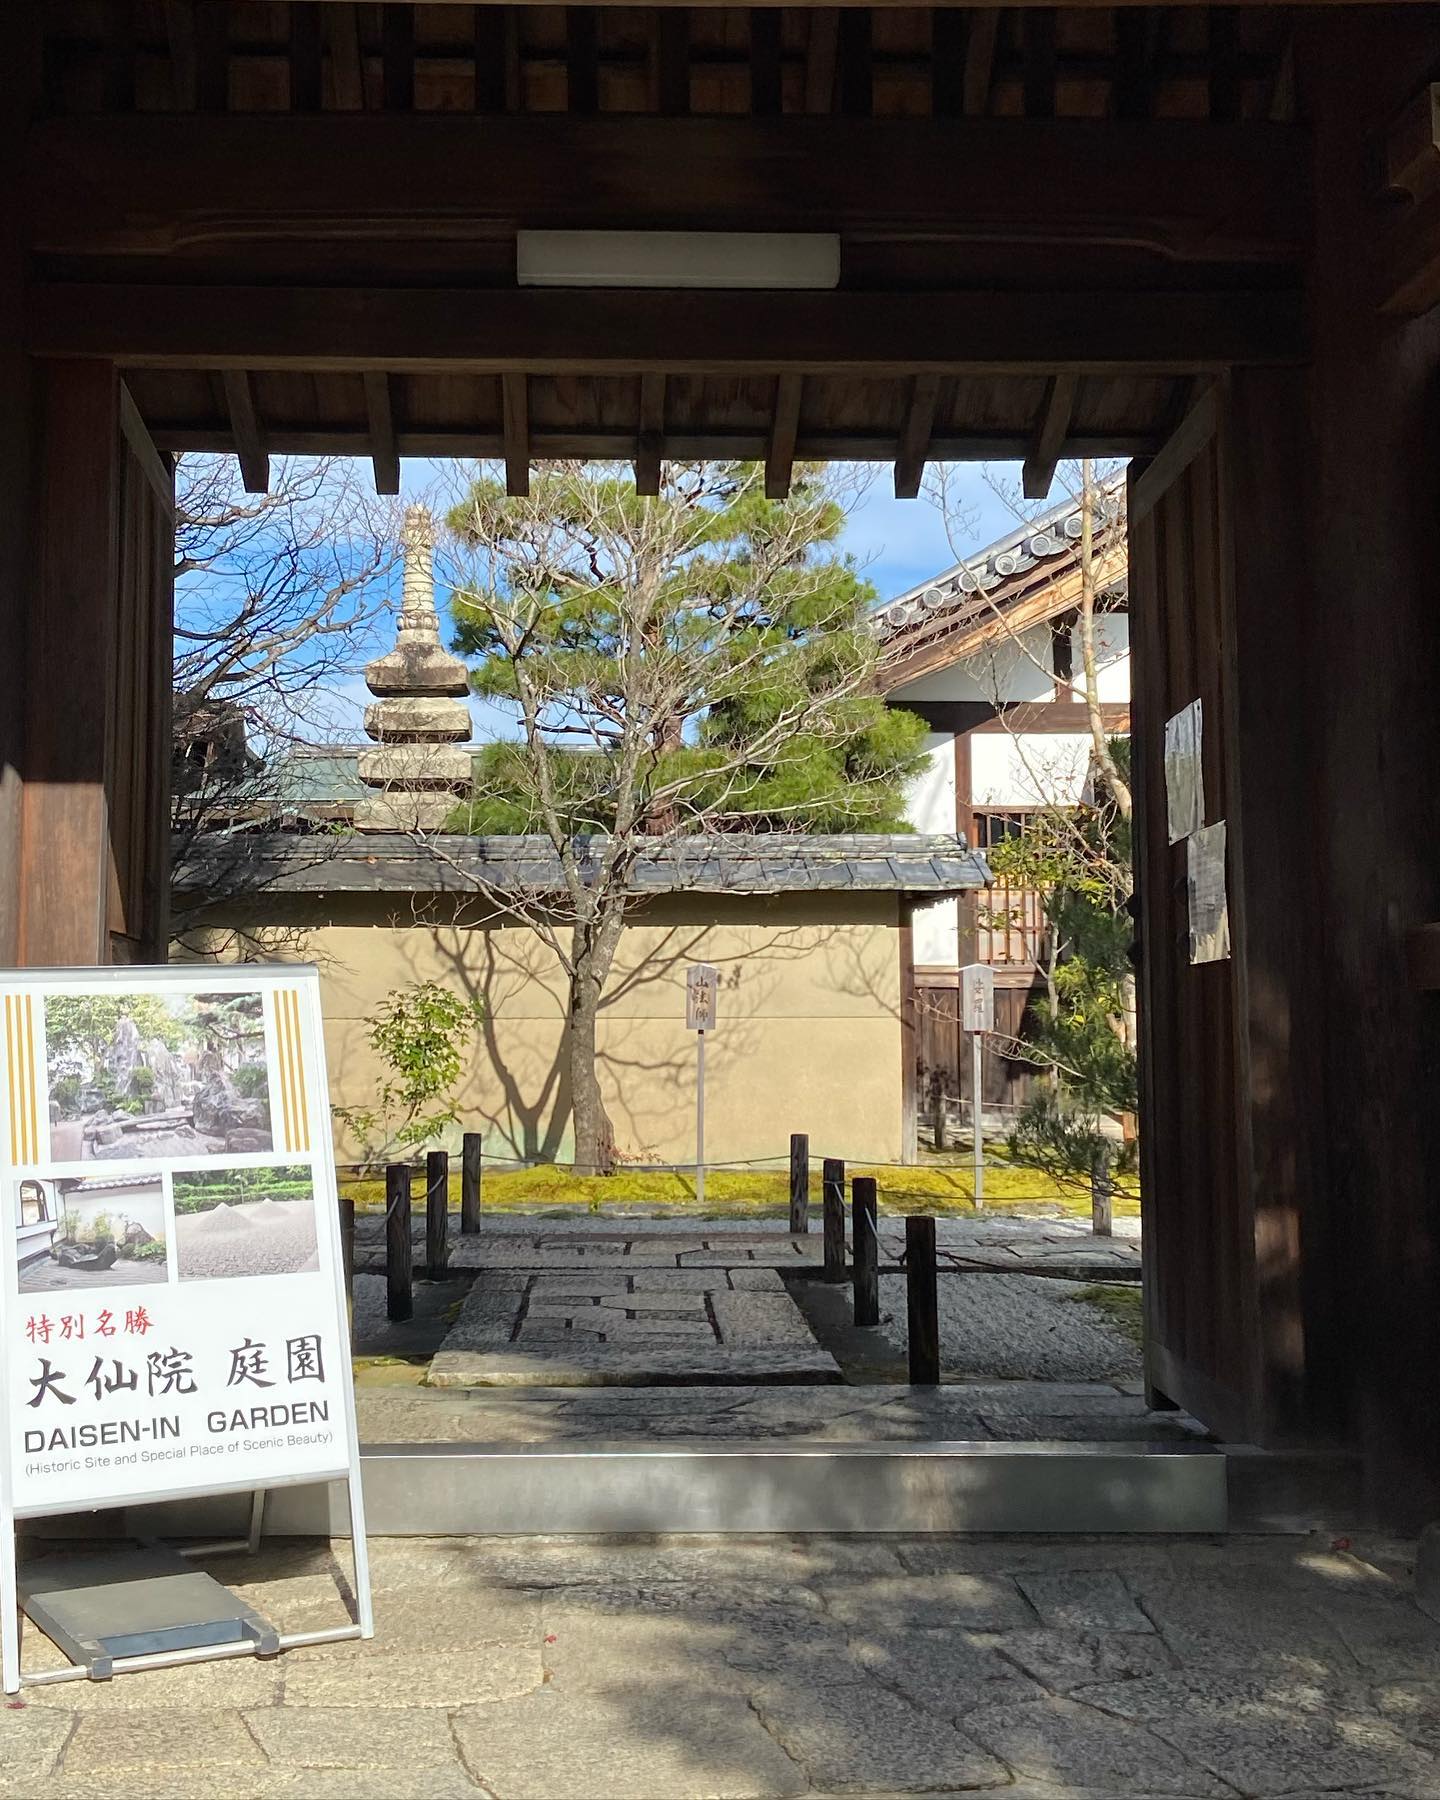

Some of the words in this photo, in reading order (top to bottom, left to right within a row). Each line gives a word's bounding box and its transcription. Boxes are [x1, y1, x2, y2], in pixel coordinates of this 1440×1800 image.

[25, 1305, 155, 1345] 特別名勝
[25, 1346, 199, 1409] 大仙院
[226, 1333, 326, 1389] 庭園
[24, 1415, 181, 1453] DAISEN-IN
[207, 1400, 330, 1433] GARDEN
[25, 1458, 81, 1477] (Historic
[84, 1456, 111, 1469] Site
[114, 1453, 137, 1465] and
[141, 1446, 186, 1465] Special
[190, 1444, 224, 1457] Place
[227, 1440, 240, 1453] of
[243, 1437, 284, 1451] Scenic
[287, 1431, 334, 1447] Beauty)
